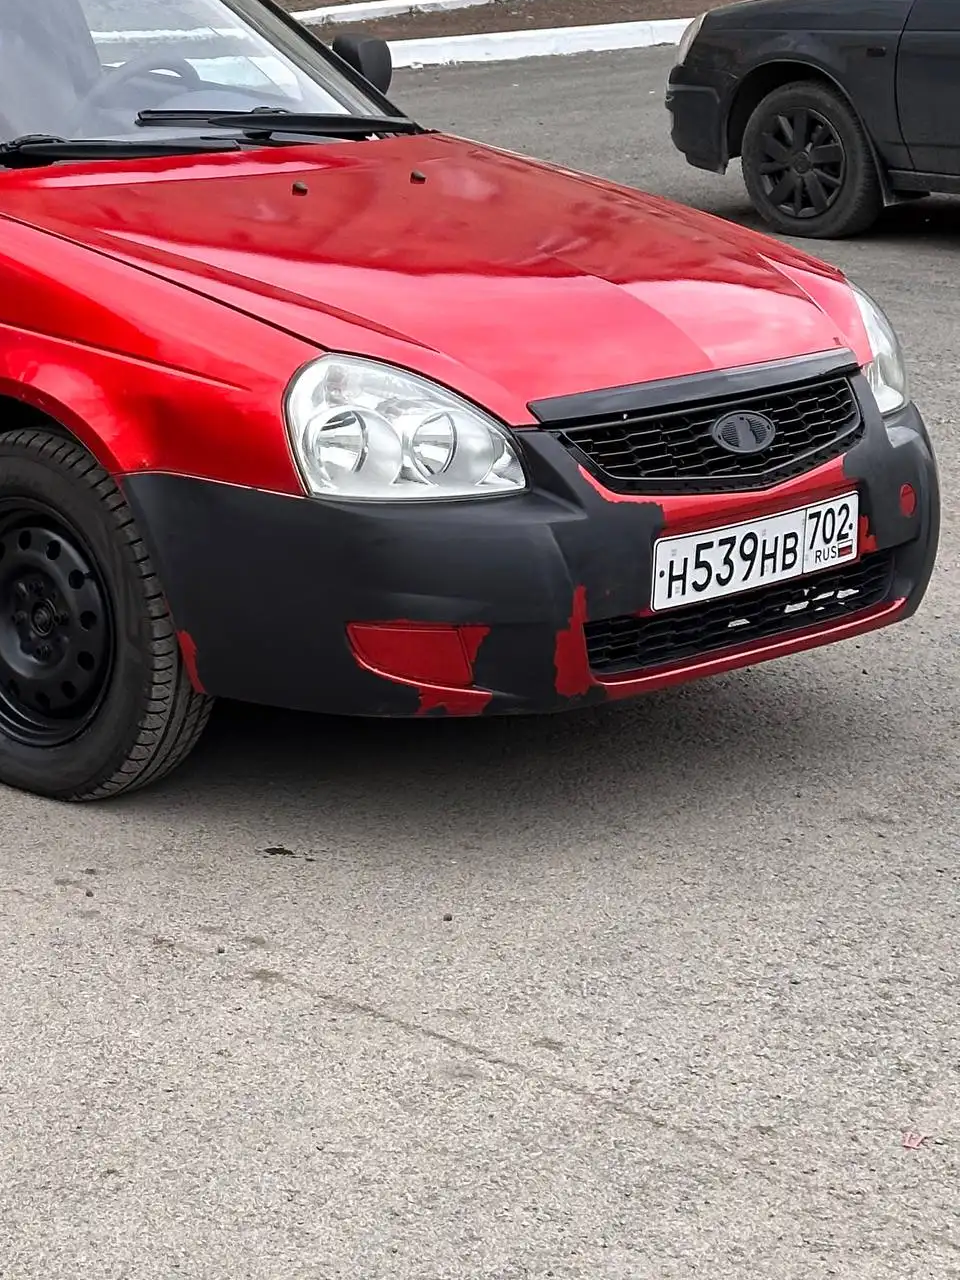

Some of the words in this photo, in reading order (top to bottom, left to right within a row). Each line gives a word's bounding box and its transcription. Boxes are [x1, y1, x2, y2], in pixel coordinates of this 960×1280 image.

[667, 531, 799, 599] Н539НВ
[808, 503, 850, 550] 702
[815, 546, 837, 564] RUS
